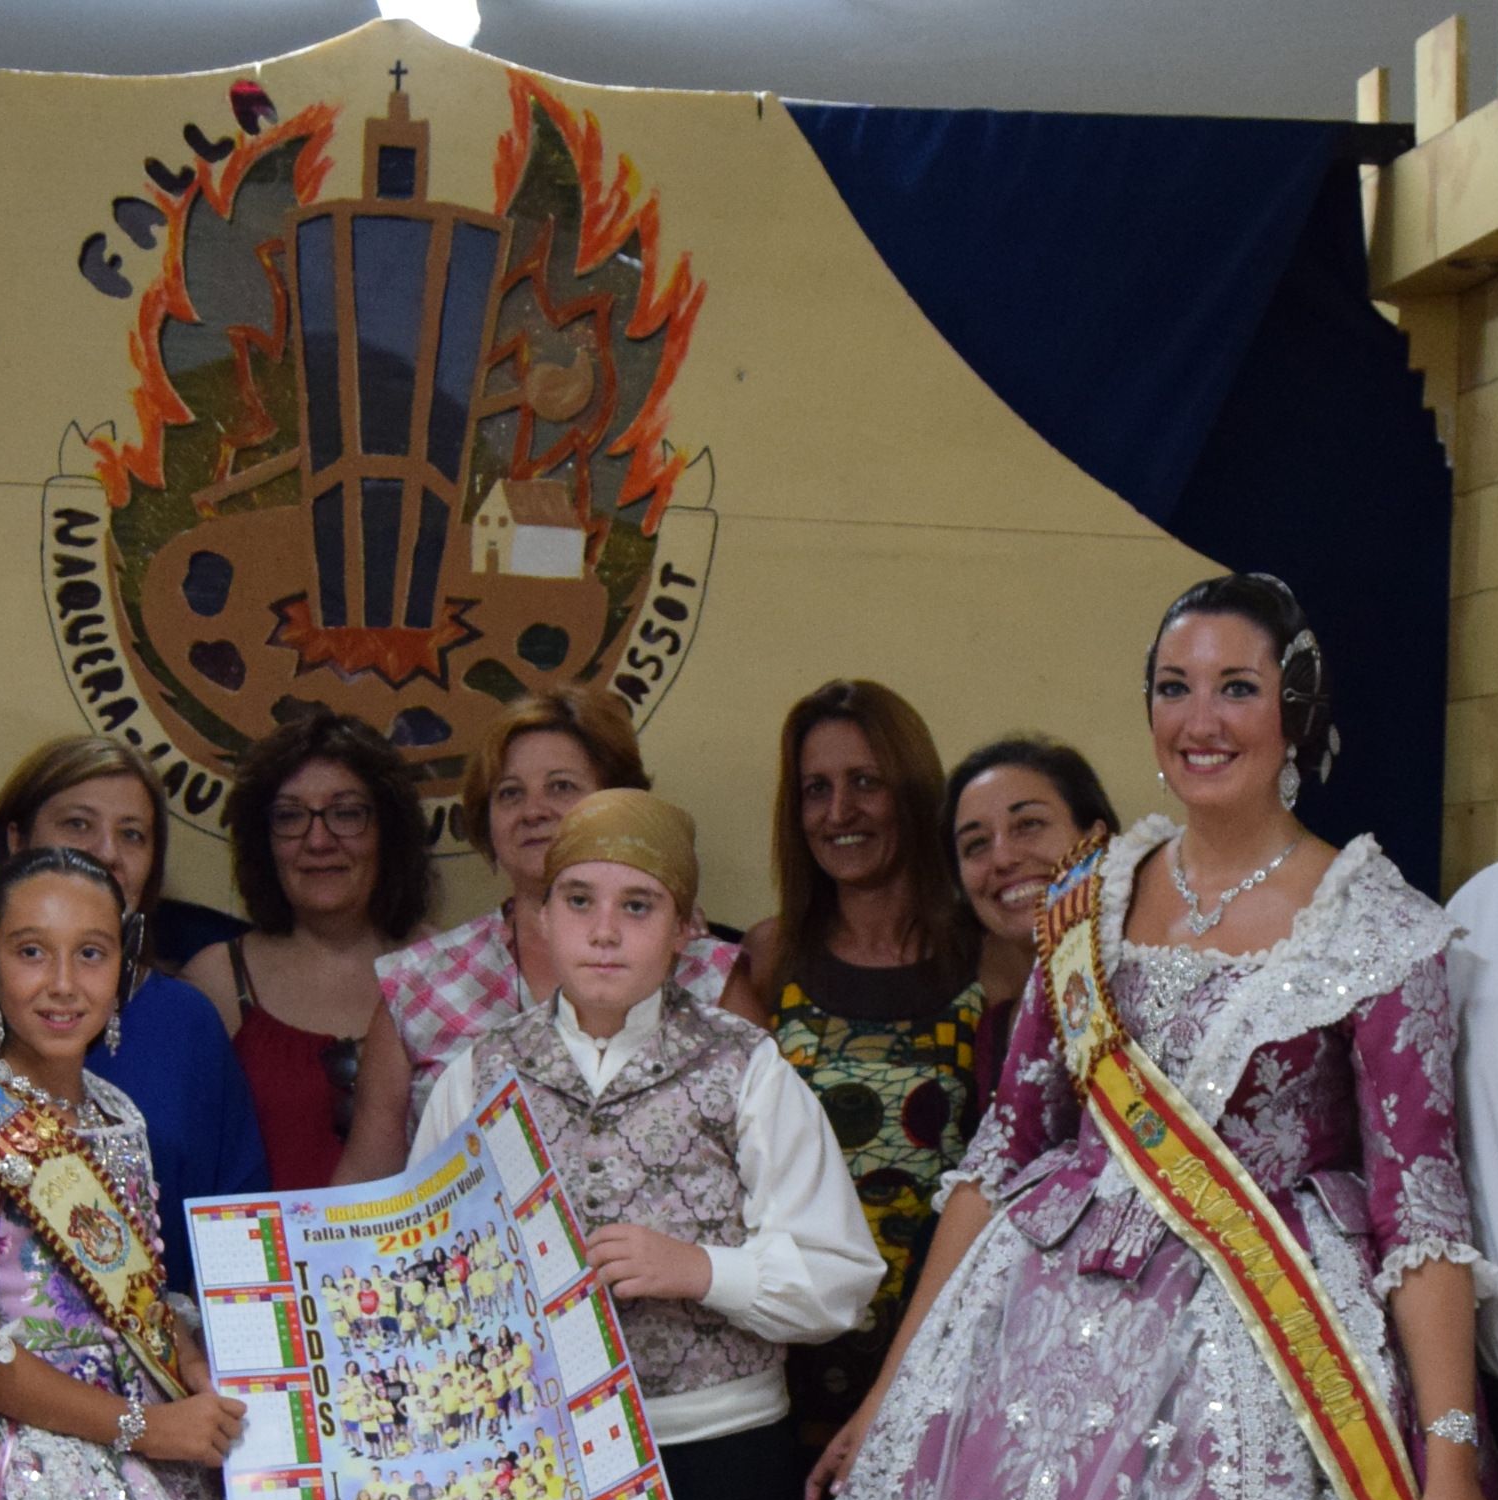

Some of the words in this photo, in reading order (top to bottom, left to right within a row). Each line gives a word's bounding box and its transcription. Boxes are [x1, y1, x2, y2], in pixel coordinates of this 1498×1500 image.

[79, 79, 278, 299] FALLA
[302, 1226, 346, 1243] Falla
[457, 1163, 486, 1197] Volpi
[376, 1211, 450, 1254] 2017
[494, 1190, 546, 1353] TODOS
[294, 1260, 337, 1438] TODOS
